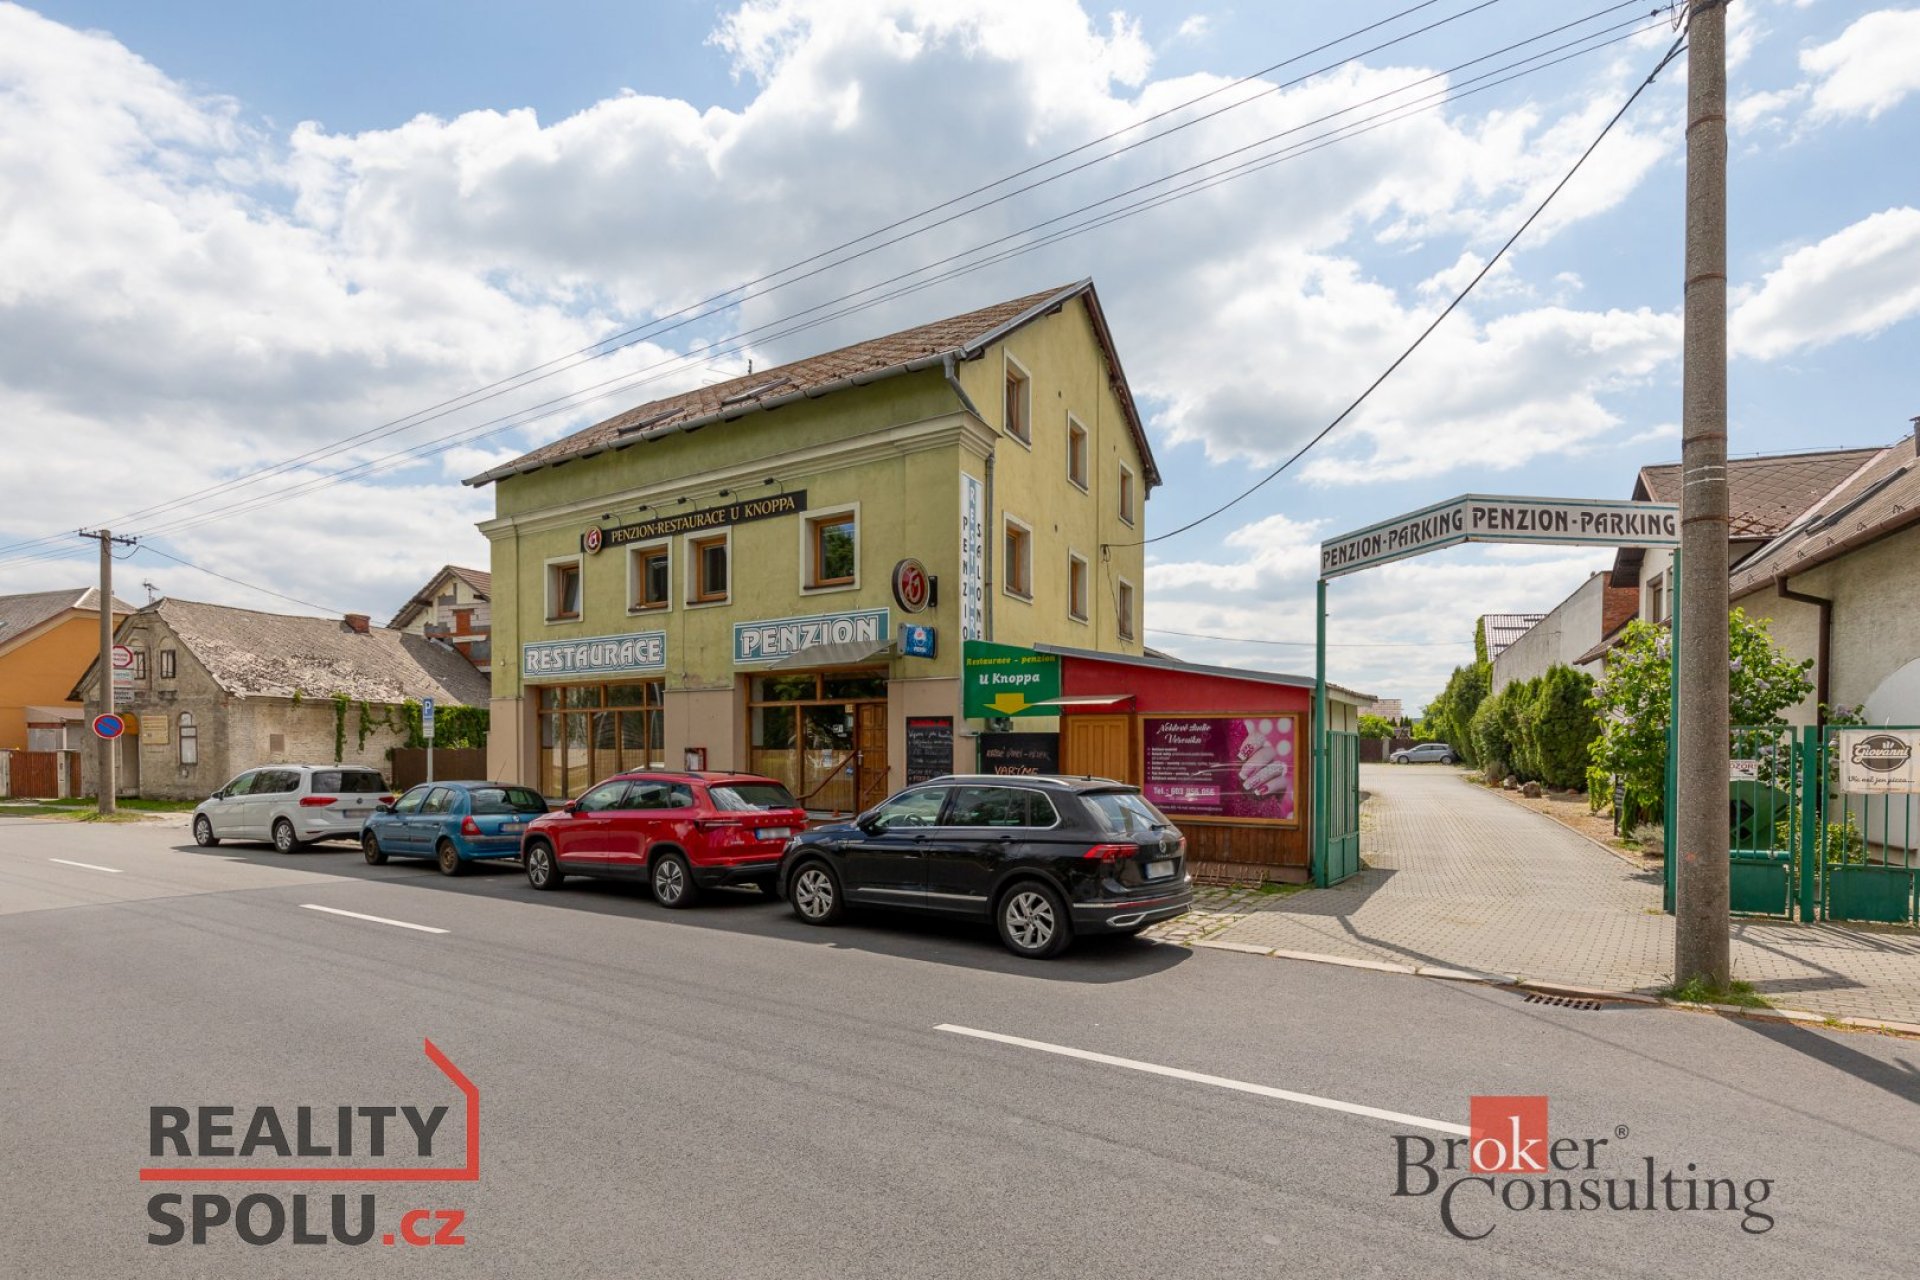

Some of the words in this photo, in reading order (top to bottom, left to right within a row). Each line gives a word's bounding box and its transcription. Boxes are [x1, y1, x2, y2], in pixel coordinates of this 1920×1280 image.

[611, 510, 725, 543] PENZION-RESTAURACE
[731, 507, 740, 520] U
[744, 496, 795, 518] KNOPPA
[1471, 506, 1676, 536] PENZION-PARKING
[1322, 508, 1463, 569] PENZION-PARKING
[740, 616, 879, 658] PENZION
[525, 638, 664, 674] RESTAURACE
[966, 657, 1011, 666] Restaurace
[1021, 656, 1056, 664] penzion
[992, 672, 1040, 686] Knoppa
[1854, 744, 1910, 762] Giovanni
